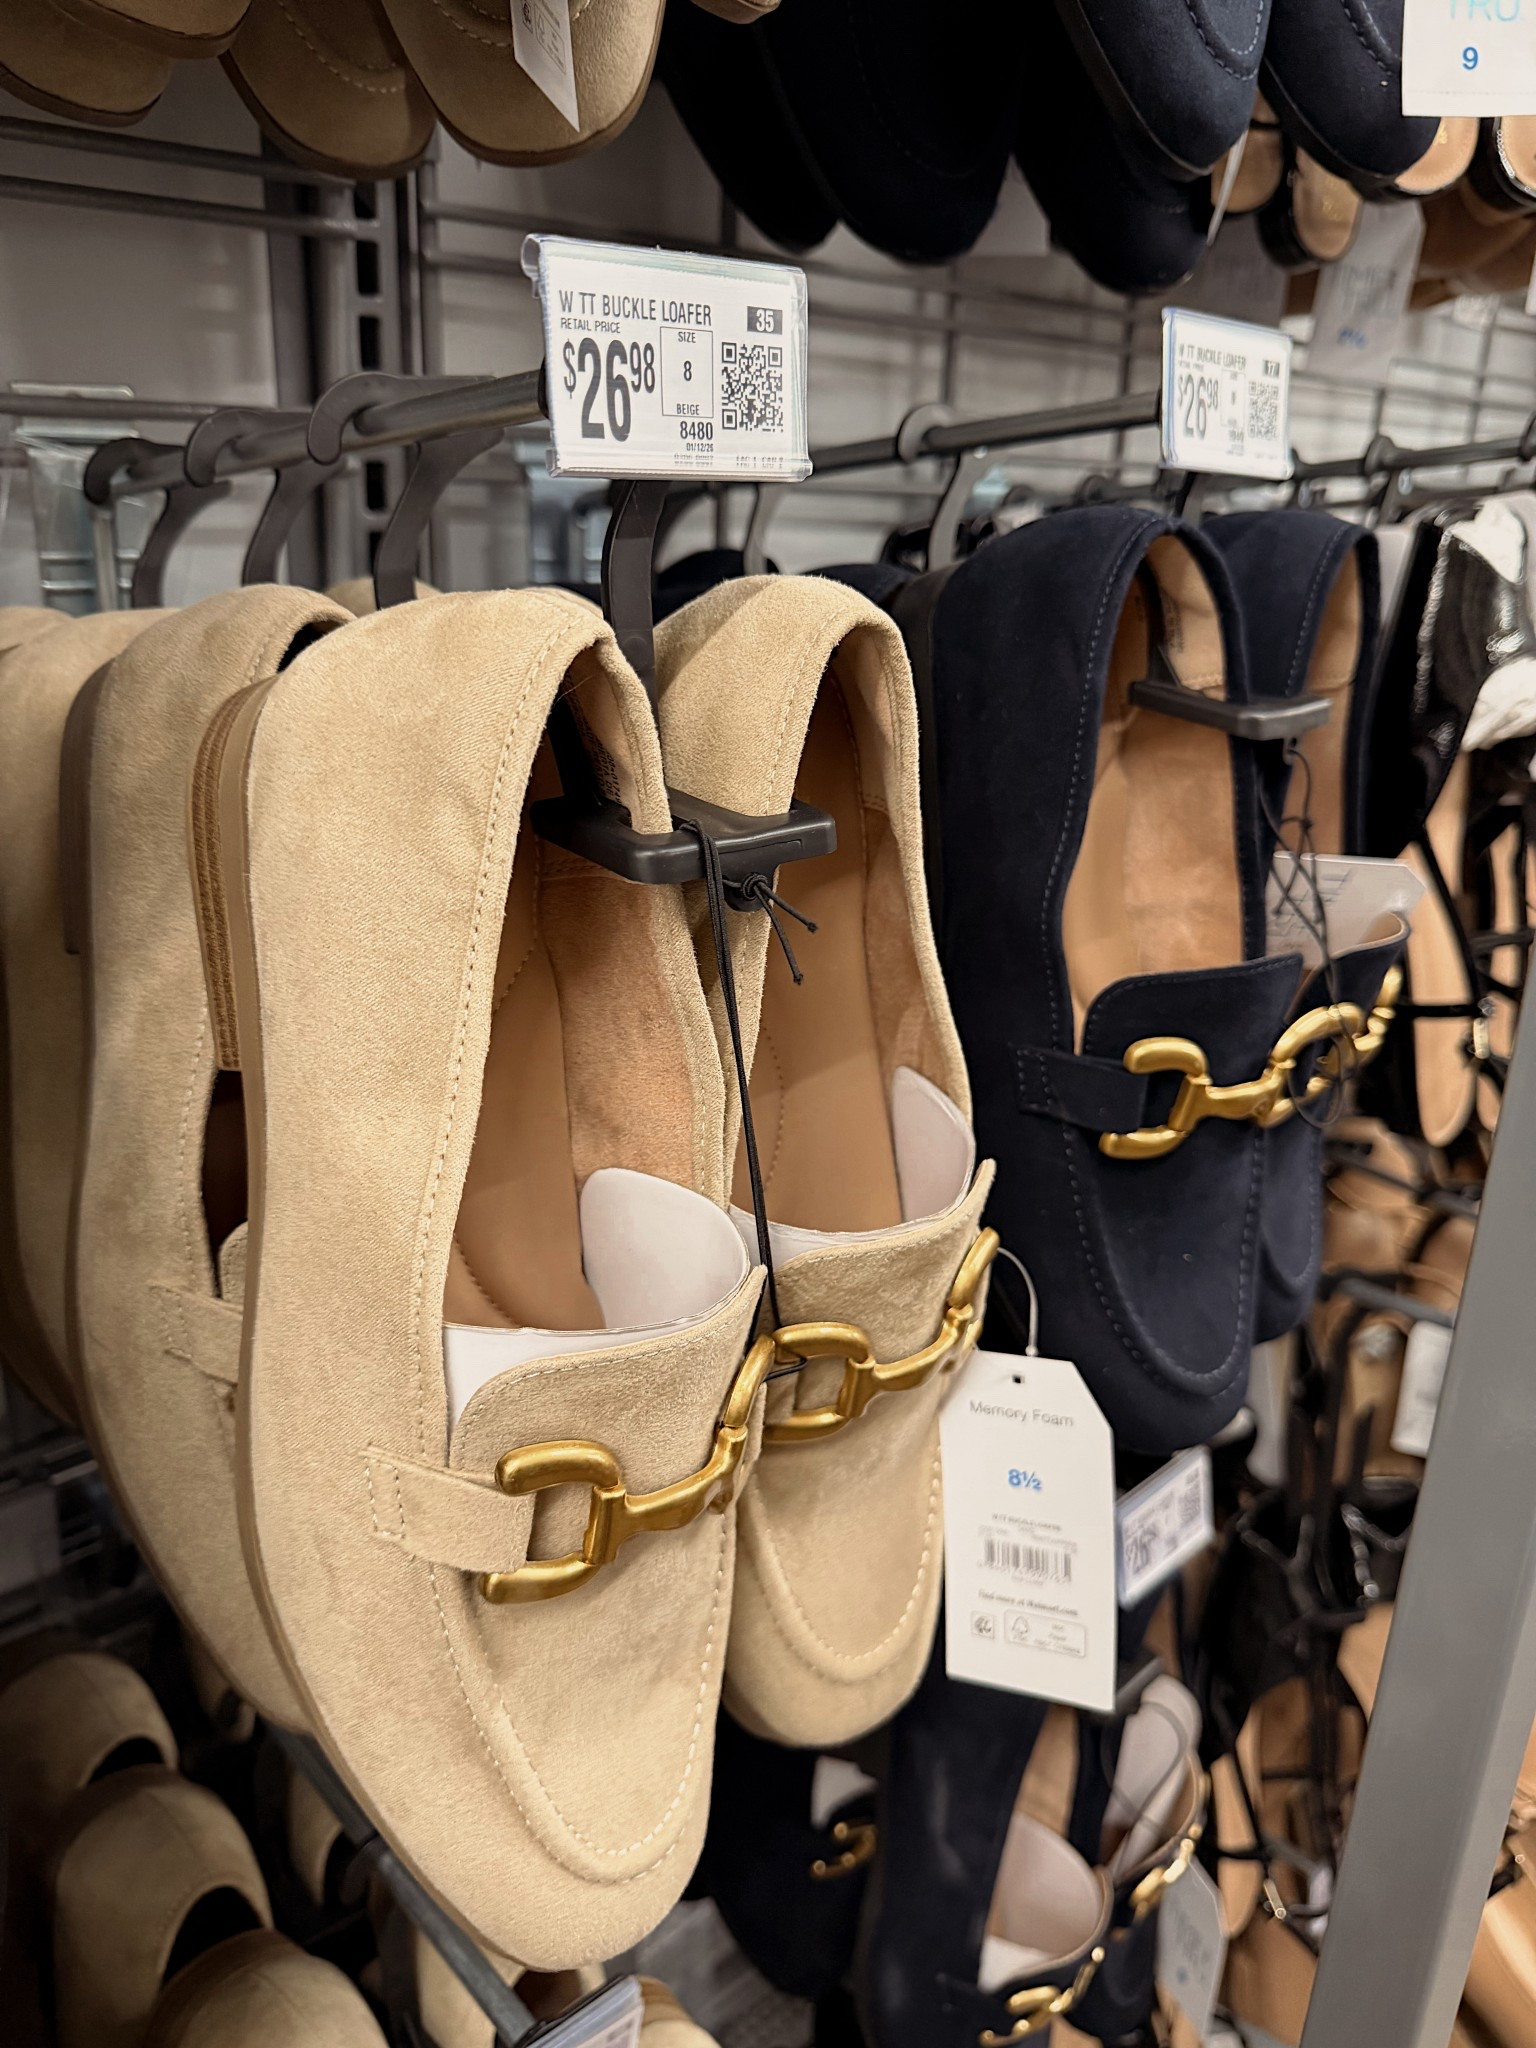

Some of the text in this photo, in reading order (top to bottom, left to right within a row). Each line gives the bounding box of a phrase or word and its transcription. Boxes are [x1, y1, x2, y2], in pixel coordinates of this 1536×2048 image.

[1462, 46, 1479, 70] 9
[559, 290, 713, 326] W TT BUCKLE LOAFER
[560, 317, 622, 334] RETAIL PRICE
[755, 308, 775, 333] 35
[677, 331, 697, 344] SIZE
[682, 360, 693, 382] 8
[676, 403, 700, 416] BEIGE
[679, 420, 714, 441] 8480
[969, 1400, 1074, 1427] Memory Foam
